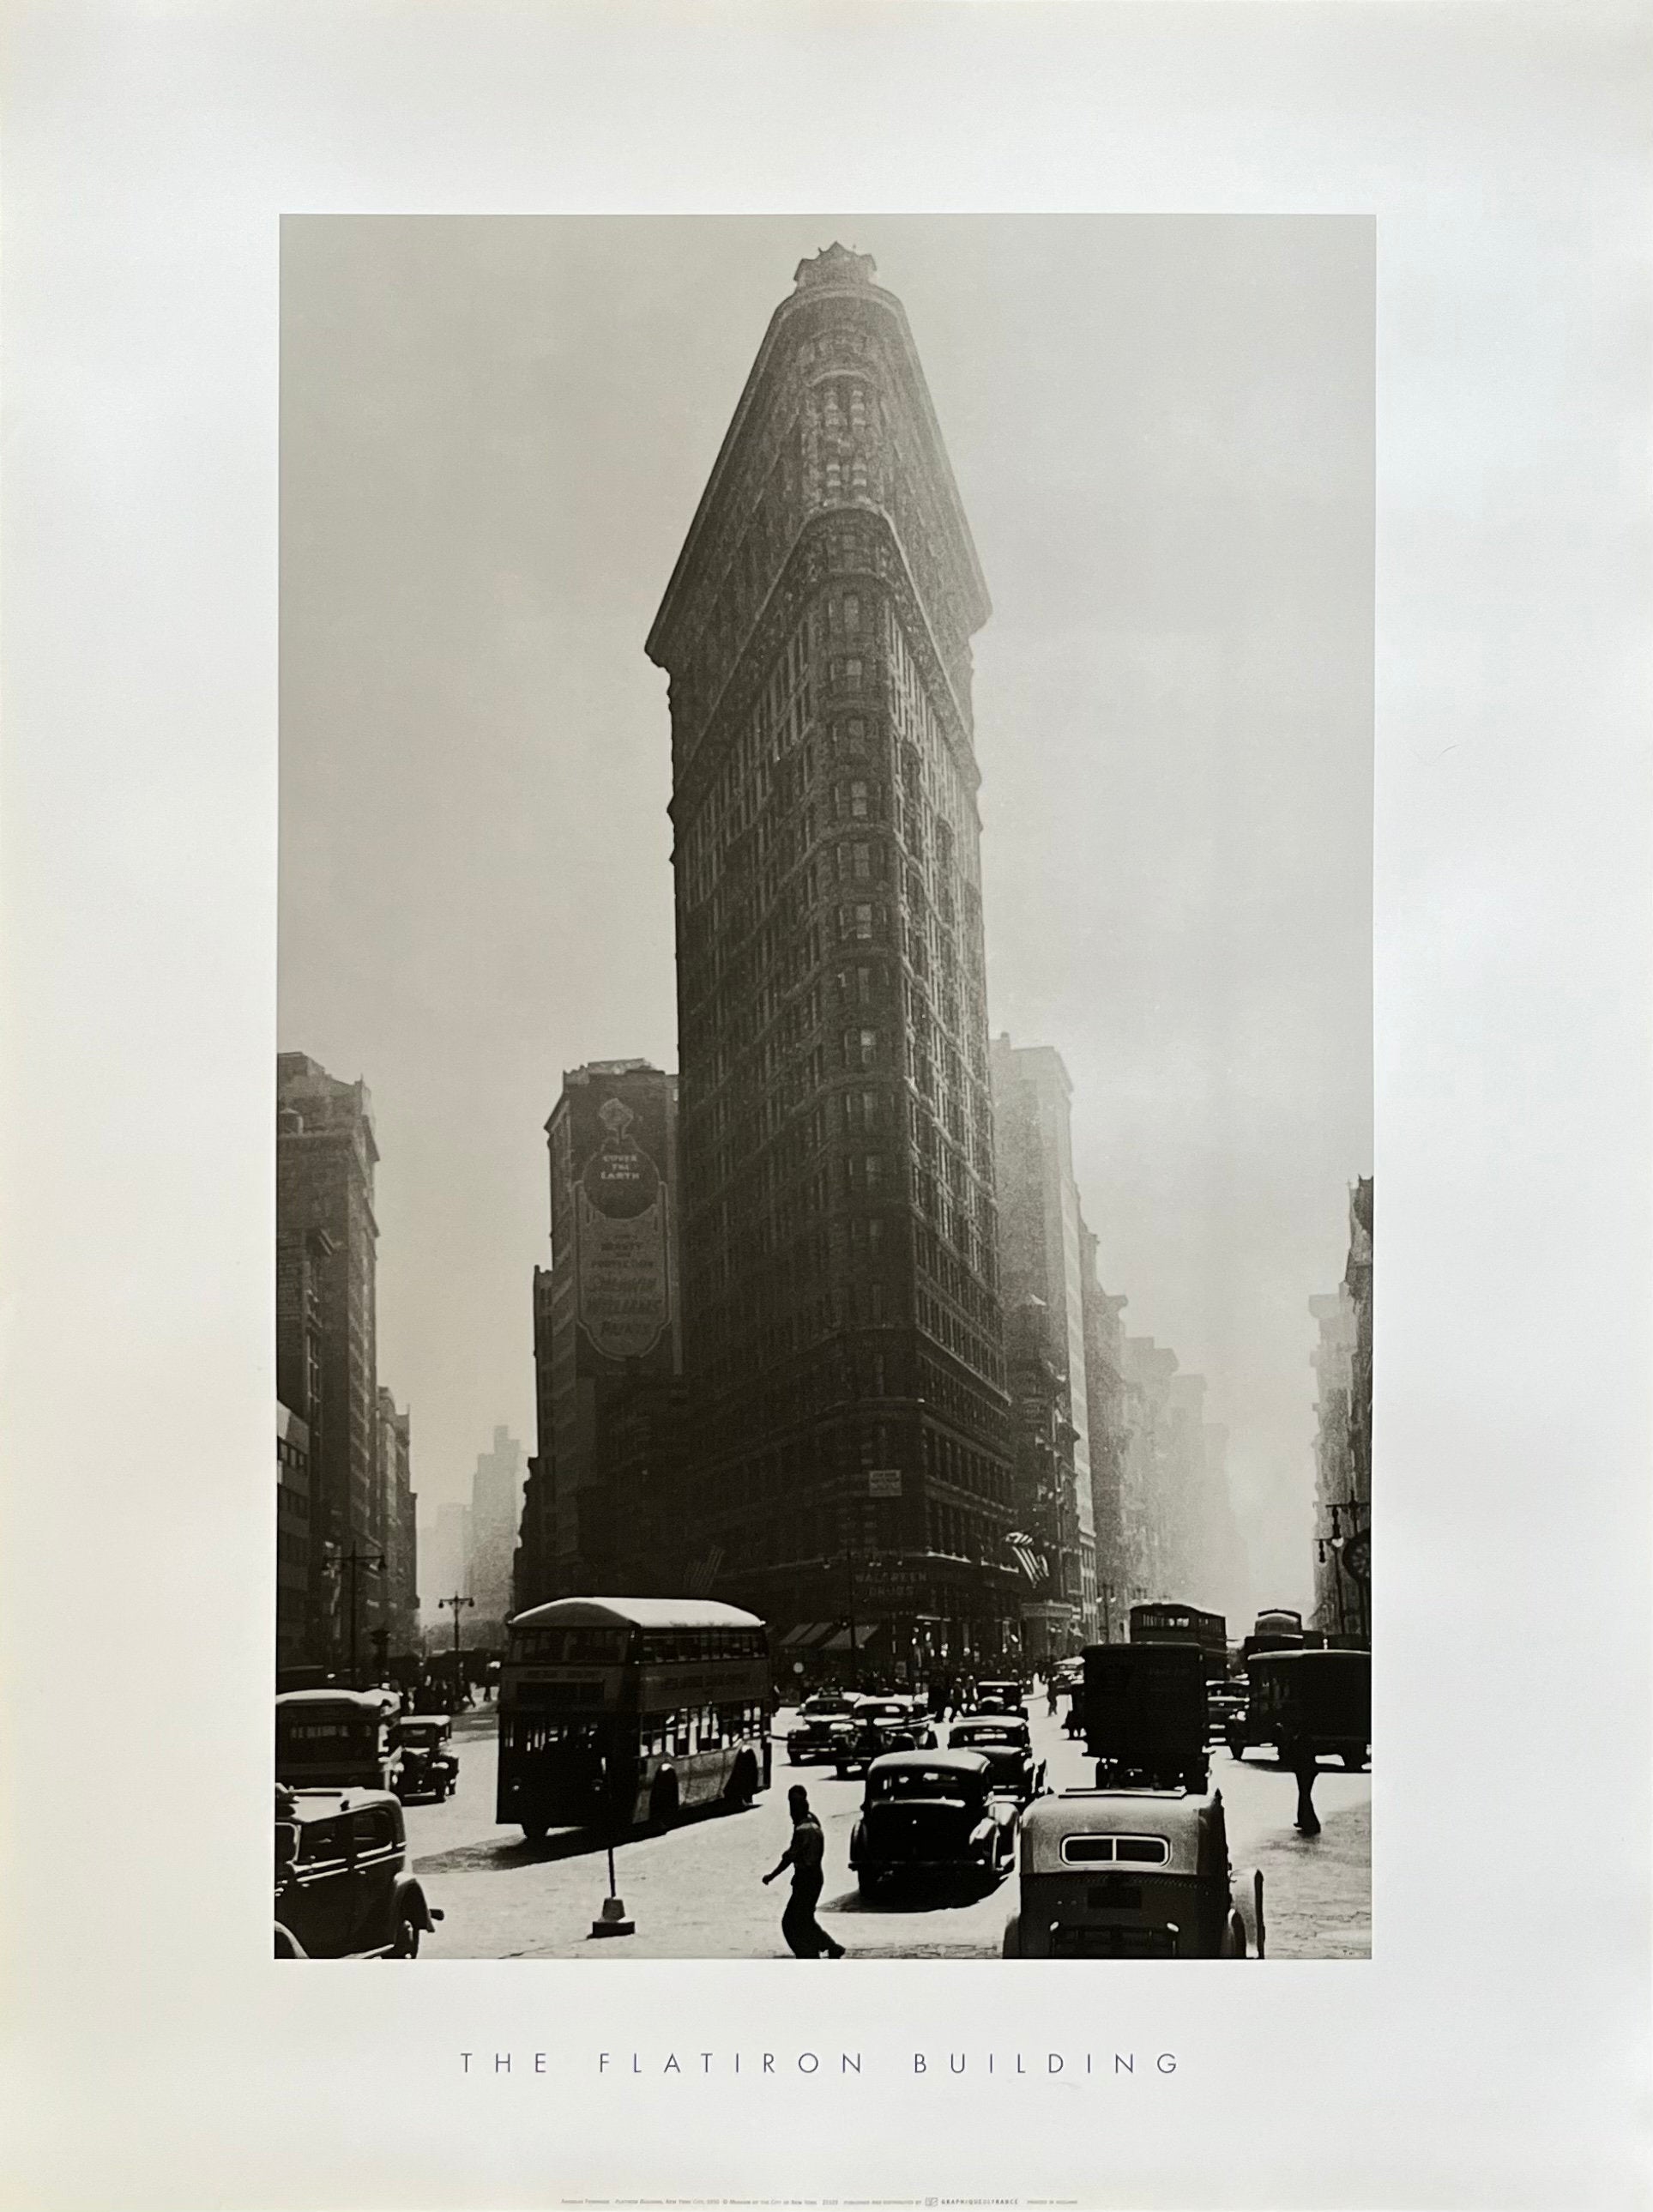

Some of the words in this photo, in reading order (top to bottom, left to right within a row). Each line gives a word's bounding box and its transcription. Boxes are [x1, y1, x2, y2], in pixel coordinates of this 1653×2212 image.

[460, 2052, 546, 2073] THE
[600, 2052, 861, 2073] FLATIRON
[914, 2052, 1177, 2073] BUILDING
